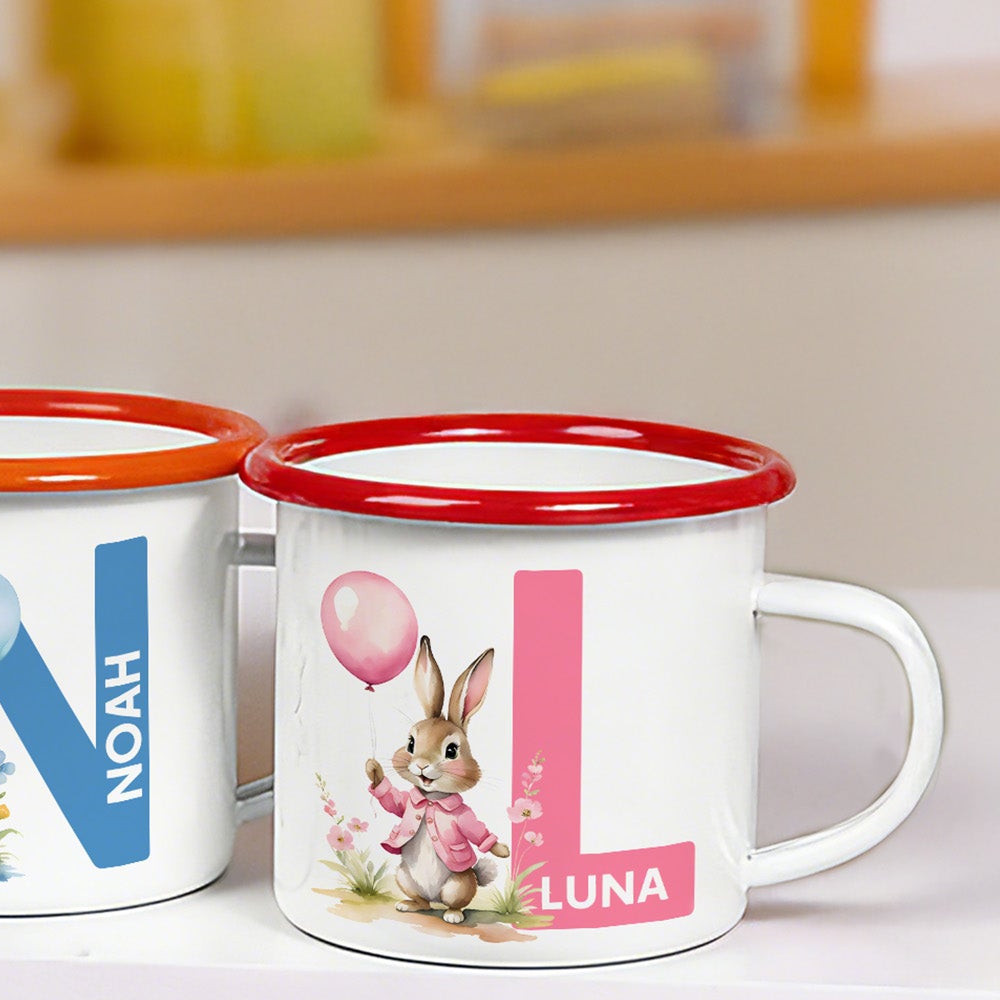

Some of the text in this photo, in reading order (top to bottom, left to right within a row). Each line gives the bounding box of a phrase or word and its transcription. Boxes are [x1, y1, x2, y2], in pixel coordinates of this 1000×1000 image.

[104, 649, 143, 804] NOAH
[511, 568, 696, 930] L
[539, 867, 670, 912] LUNA
